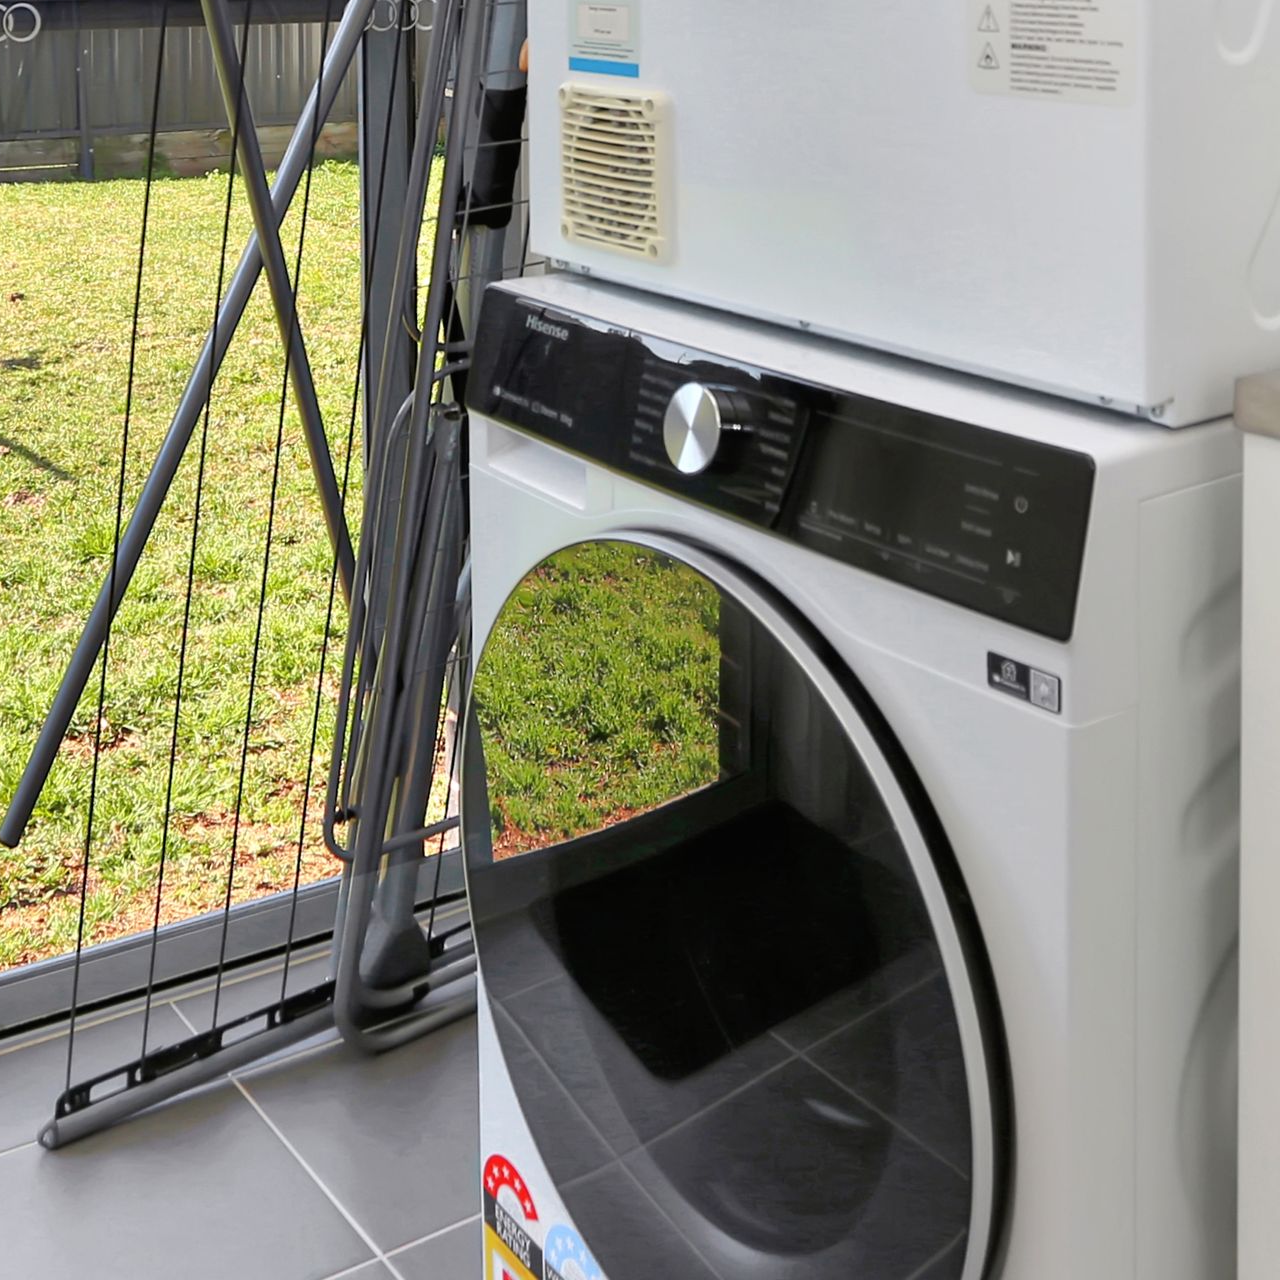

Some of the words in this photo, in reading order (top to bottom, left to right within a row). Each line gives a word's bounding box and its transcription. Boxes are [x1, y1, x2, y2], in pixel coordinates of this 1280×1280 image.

[524, 313, 569, 341] Hisense
[494, 1203, 530, 1252] ENERGY
[496, 1218, 531, 1269] RATING
